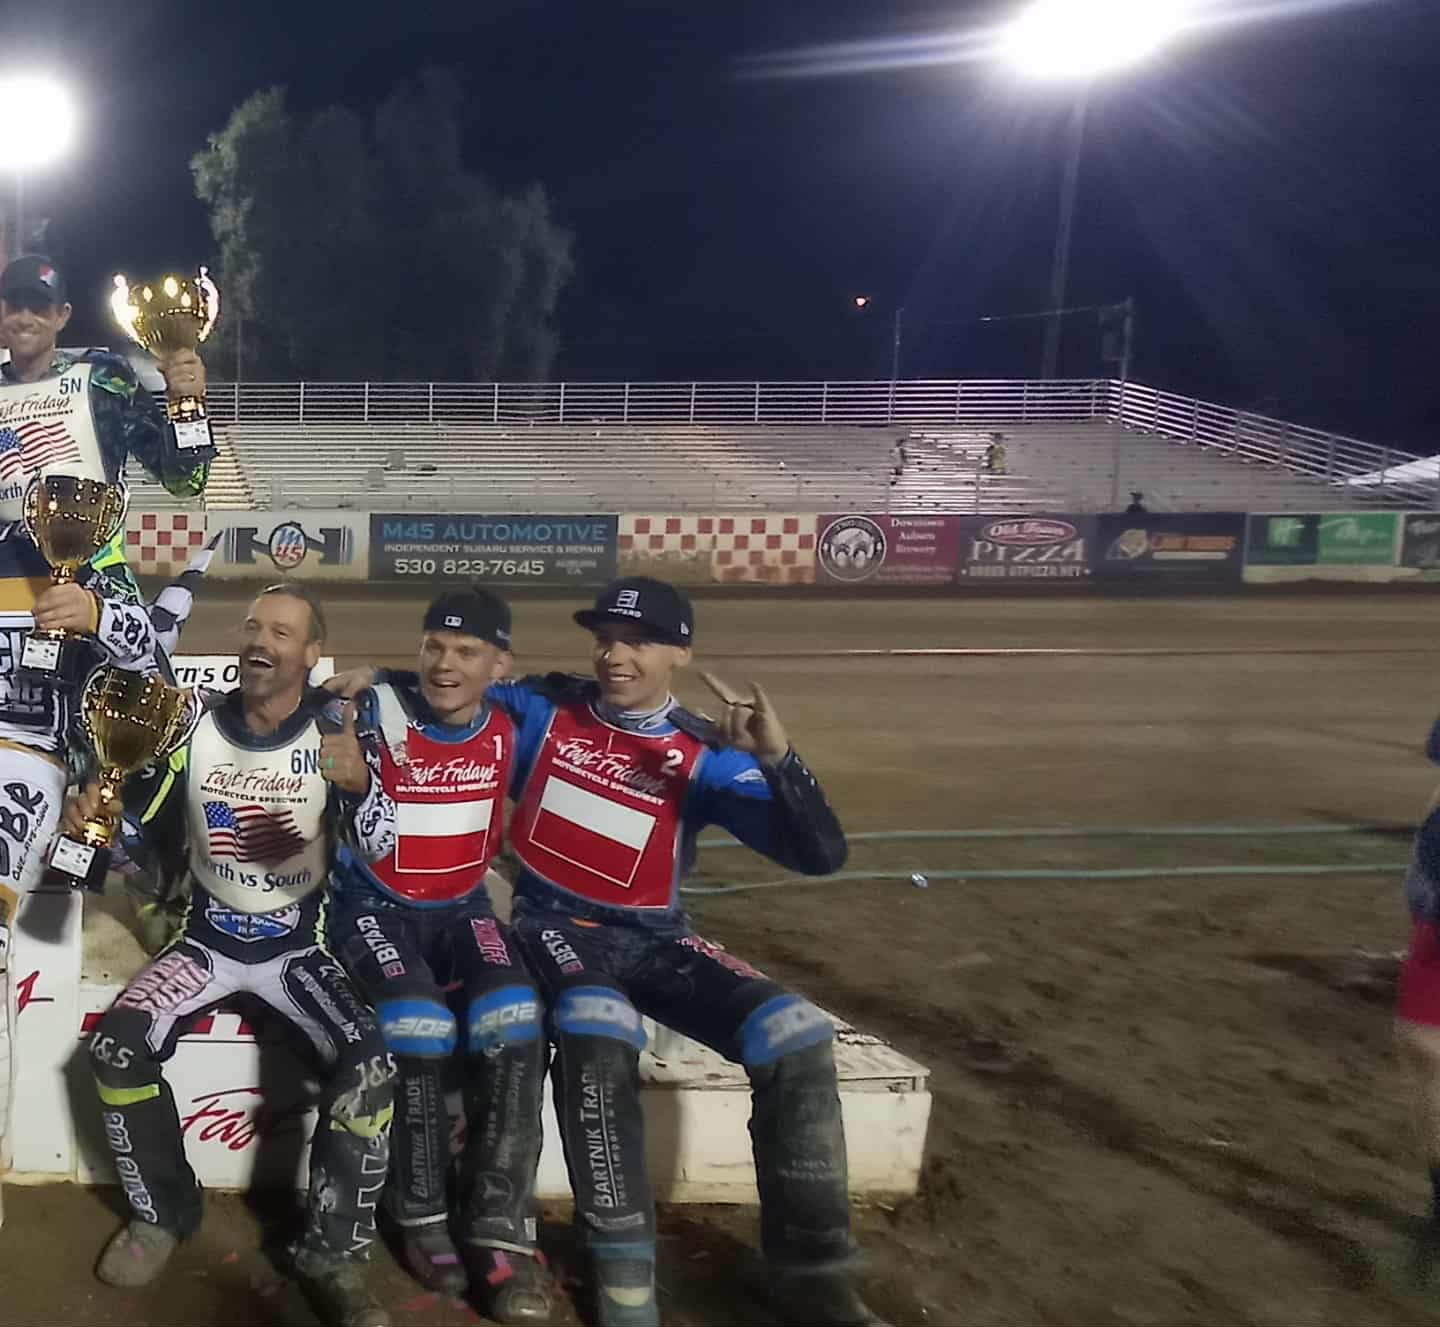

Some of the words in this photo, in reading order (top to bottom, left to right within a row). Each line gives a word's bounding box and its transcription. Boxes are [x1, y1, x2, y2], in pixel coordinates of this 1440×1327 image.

[59, 377, 82, 396] 5N
[21, 392, 72, 414] Fridays
[33, 409, 74, 420] SPEEDWAY
[383, 523, 434, 541] M45
[442, 523, 608, 541] AUTOMOTIVE
[384, 544, 459, 553] INDEPENDENT
[463, 545, 506, 553] SUBARU
[509, 545, 554, 553] SERVICE
[563, 545, 604, 553] REPAIR
[971, 538, 1085, 562] PIZZA
[395, 559, 436, 574] 530
[443, 560, 545, 575] 823-7645
[492, 735, 503, 760] 1
[557, 738, 602, 767] Fast
[290, 749, 318, 775] 6N
[441, 757, 498, 781] Fridays
[662, 749, 684, 775] 2
[204, 762, 244, 786] Fast
[241, 767, 307, 793] Fridays
[200, 785, 256, 802] MOTORCYCLE
[259, 795, 308, 804] SPEEDWAY
[240, 872, 257, 888] vs
[262, 867, 312, 892] South
[407, 1076, 421, 1124] TRADE
[585, 1127, 615, 1209] BARTNIK
